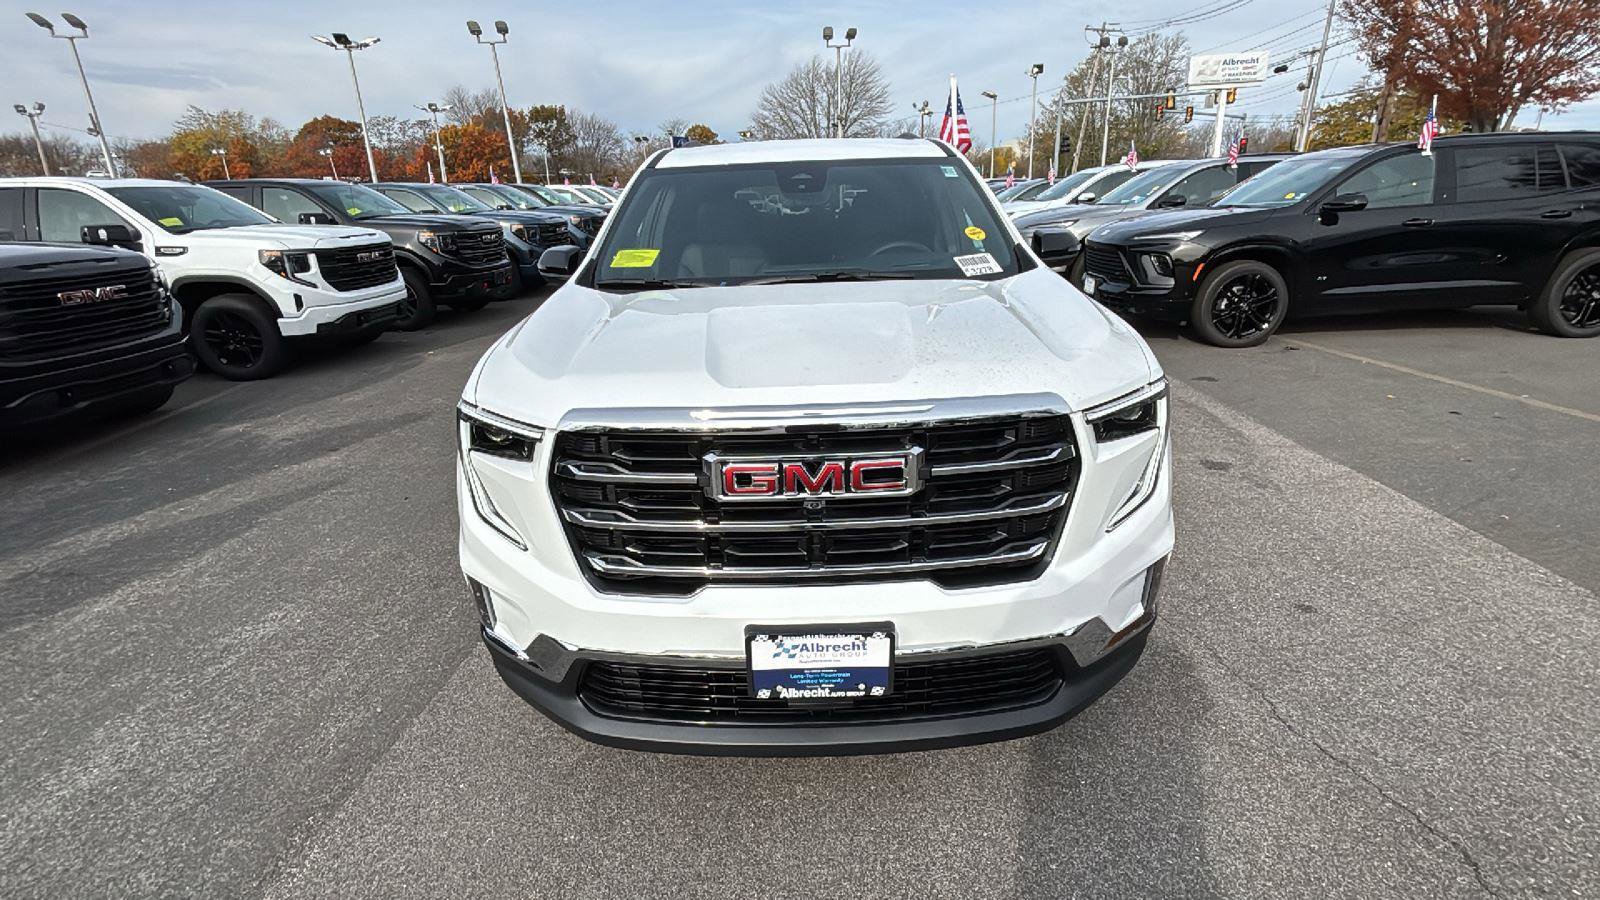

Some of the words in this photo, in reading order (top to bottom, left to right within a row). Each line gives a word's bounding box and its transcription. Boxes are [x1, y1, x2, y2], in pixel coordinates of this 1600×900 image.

[1221, 57, 1259, 66] Albrecht
[57, 284, 127, 305] GMC
[721, 457, 907, 496] GMC
[799, 641, 868, 653] Albrecht
[779, 687, 831, 699] Albrecht
